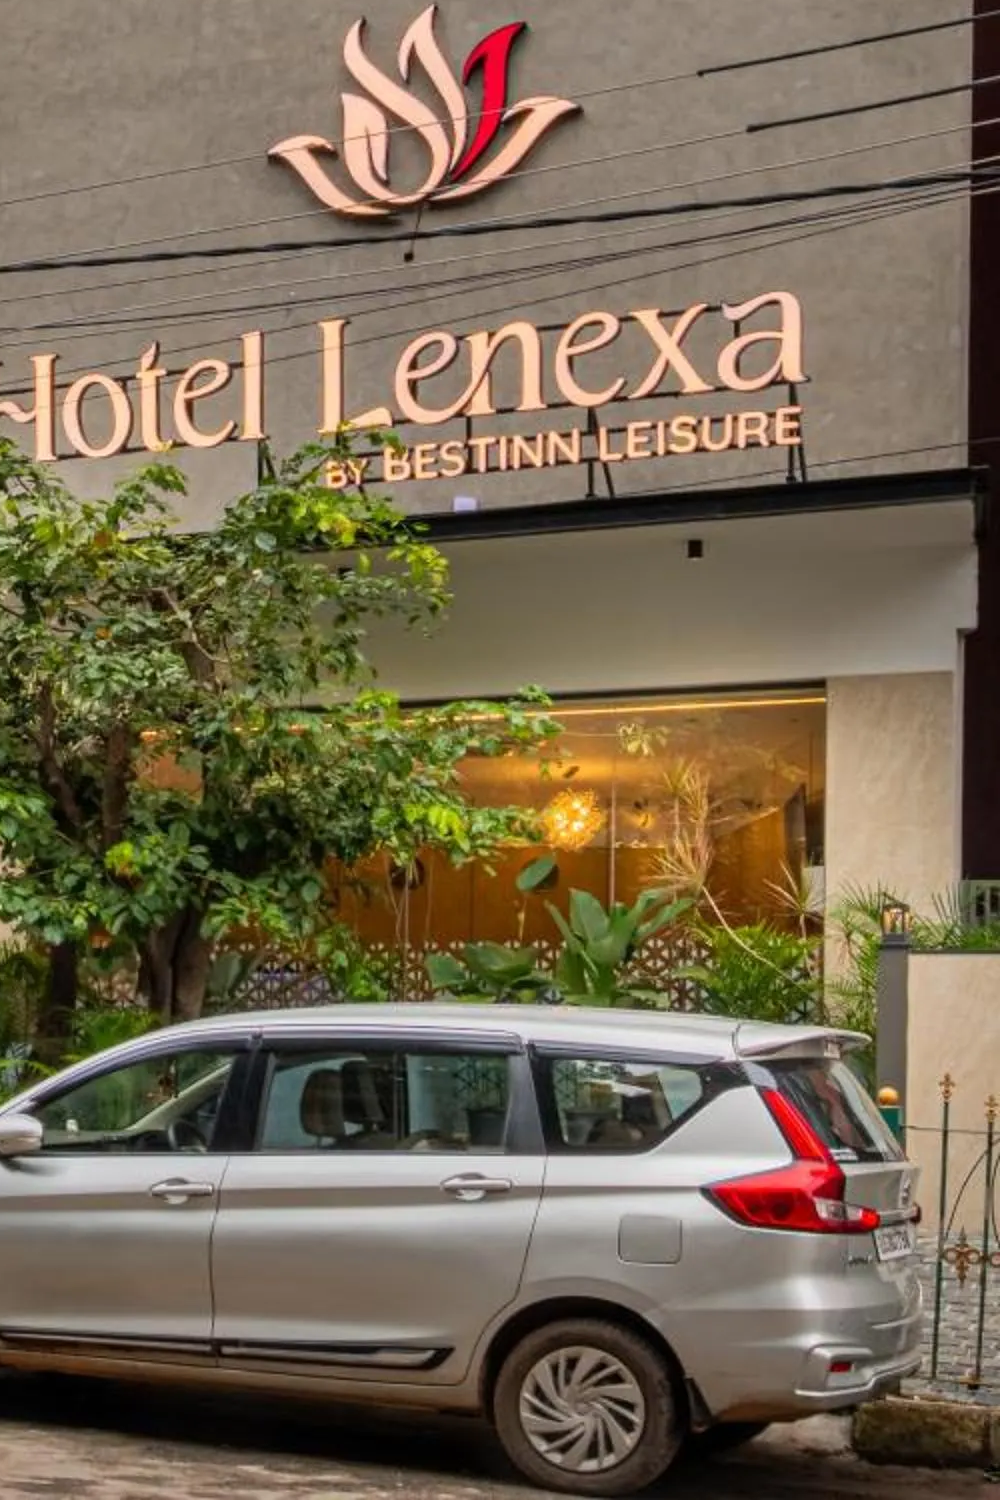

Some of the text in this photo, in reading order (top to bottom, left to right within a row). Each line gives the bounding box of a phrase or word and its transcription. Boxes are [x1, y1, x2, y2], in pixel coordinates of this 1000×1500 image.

[317, 291, 807, 435] Lenexa
[326, 405, 803, 490] BY BESTINN LEISURE
